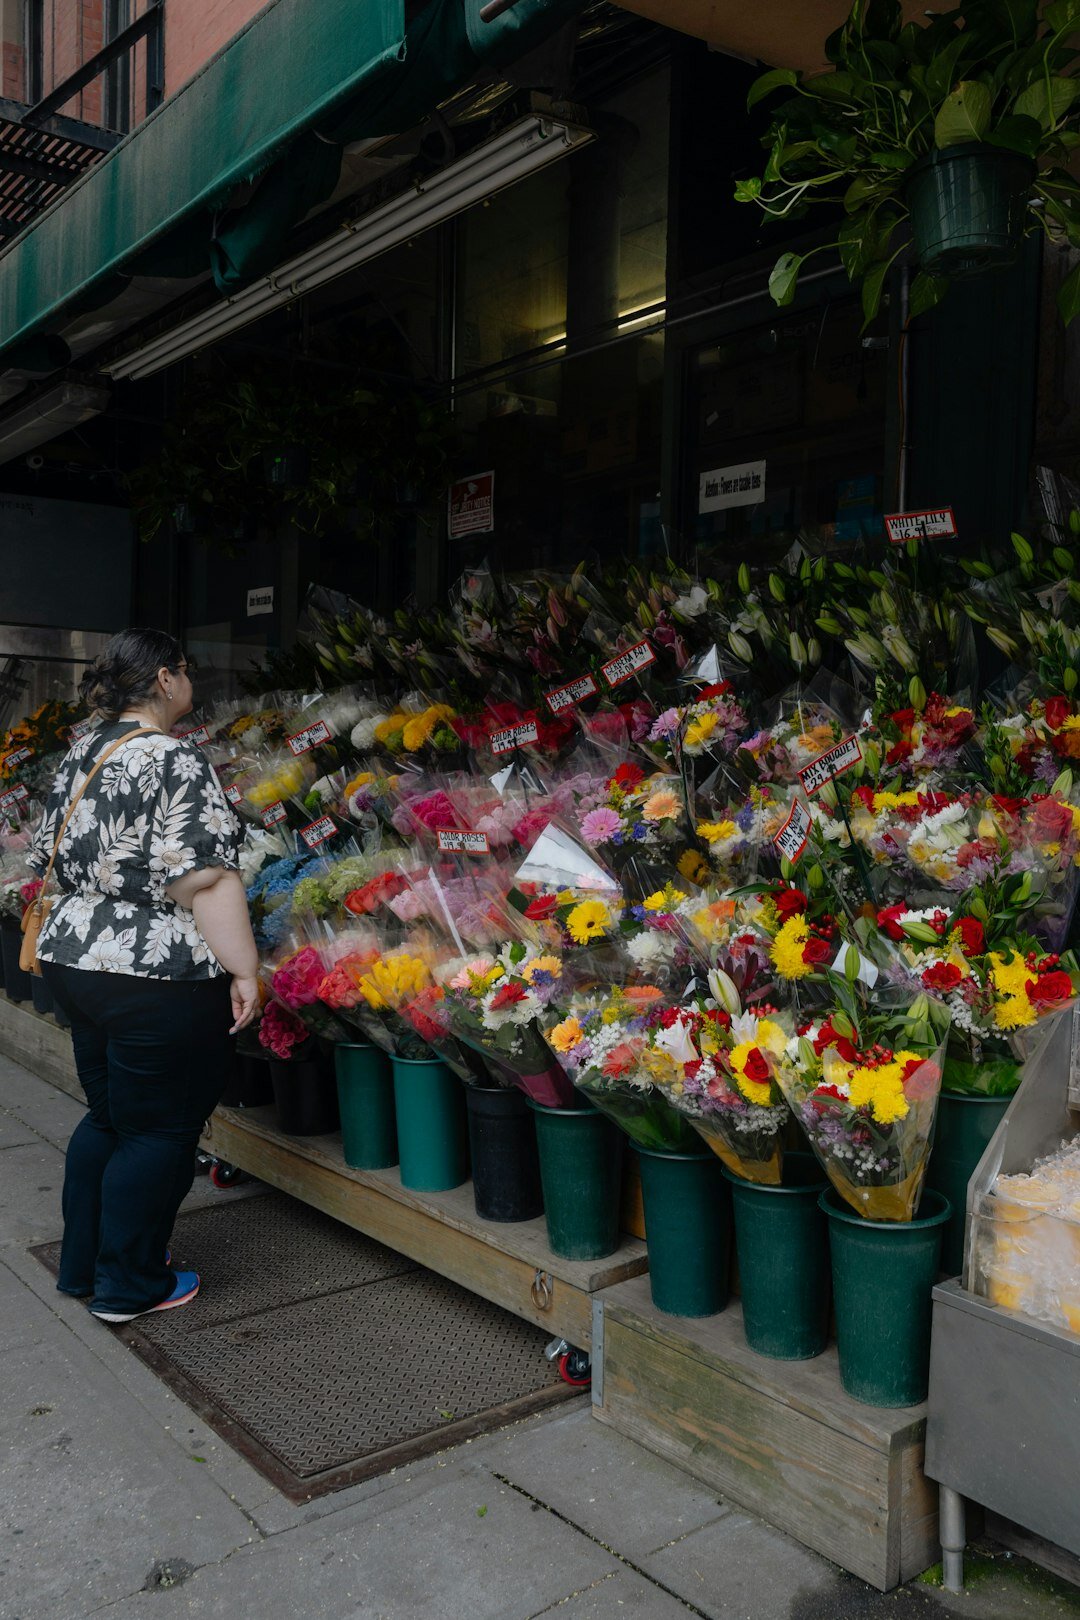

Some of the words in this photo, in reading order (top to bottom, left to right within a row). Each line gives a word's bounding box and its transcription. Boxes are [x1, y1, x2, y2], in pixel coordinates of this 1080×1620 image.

[889, 515, 923, 530] WHITE
[925, 512, 946, 525] LILY
[550, 690, 563, 704] RED
[565, 679, 588, 696] ROSES
[491, 730, 512, 744] COLOR
[513, 722, 536, 737] ROSES
[801, 763, 820, 783] MIX
[818, 739, 857, 771] BOUQUET
[440, 831, 460, 841] COLOR
[461, 832, 485, 843] ROSES
[778, 829, 793, 850] MIX
